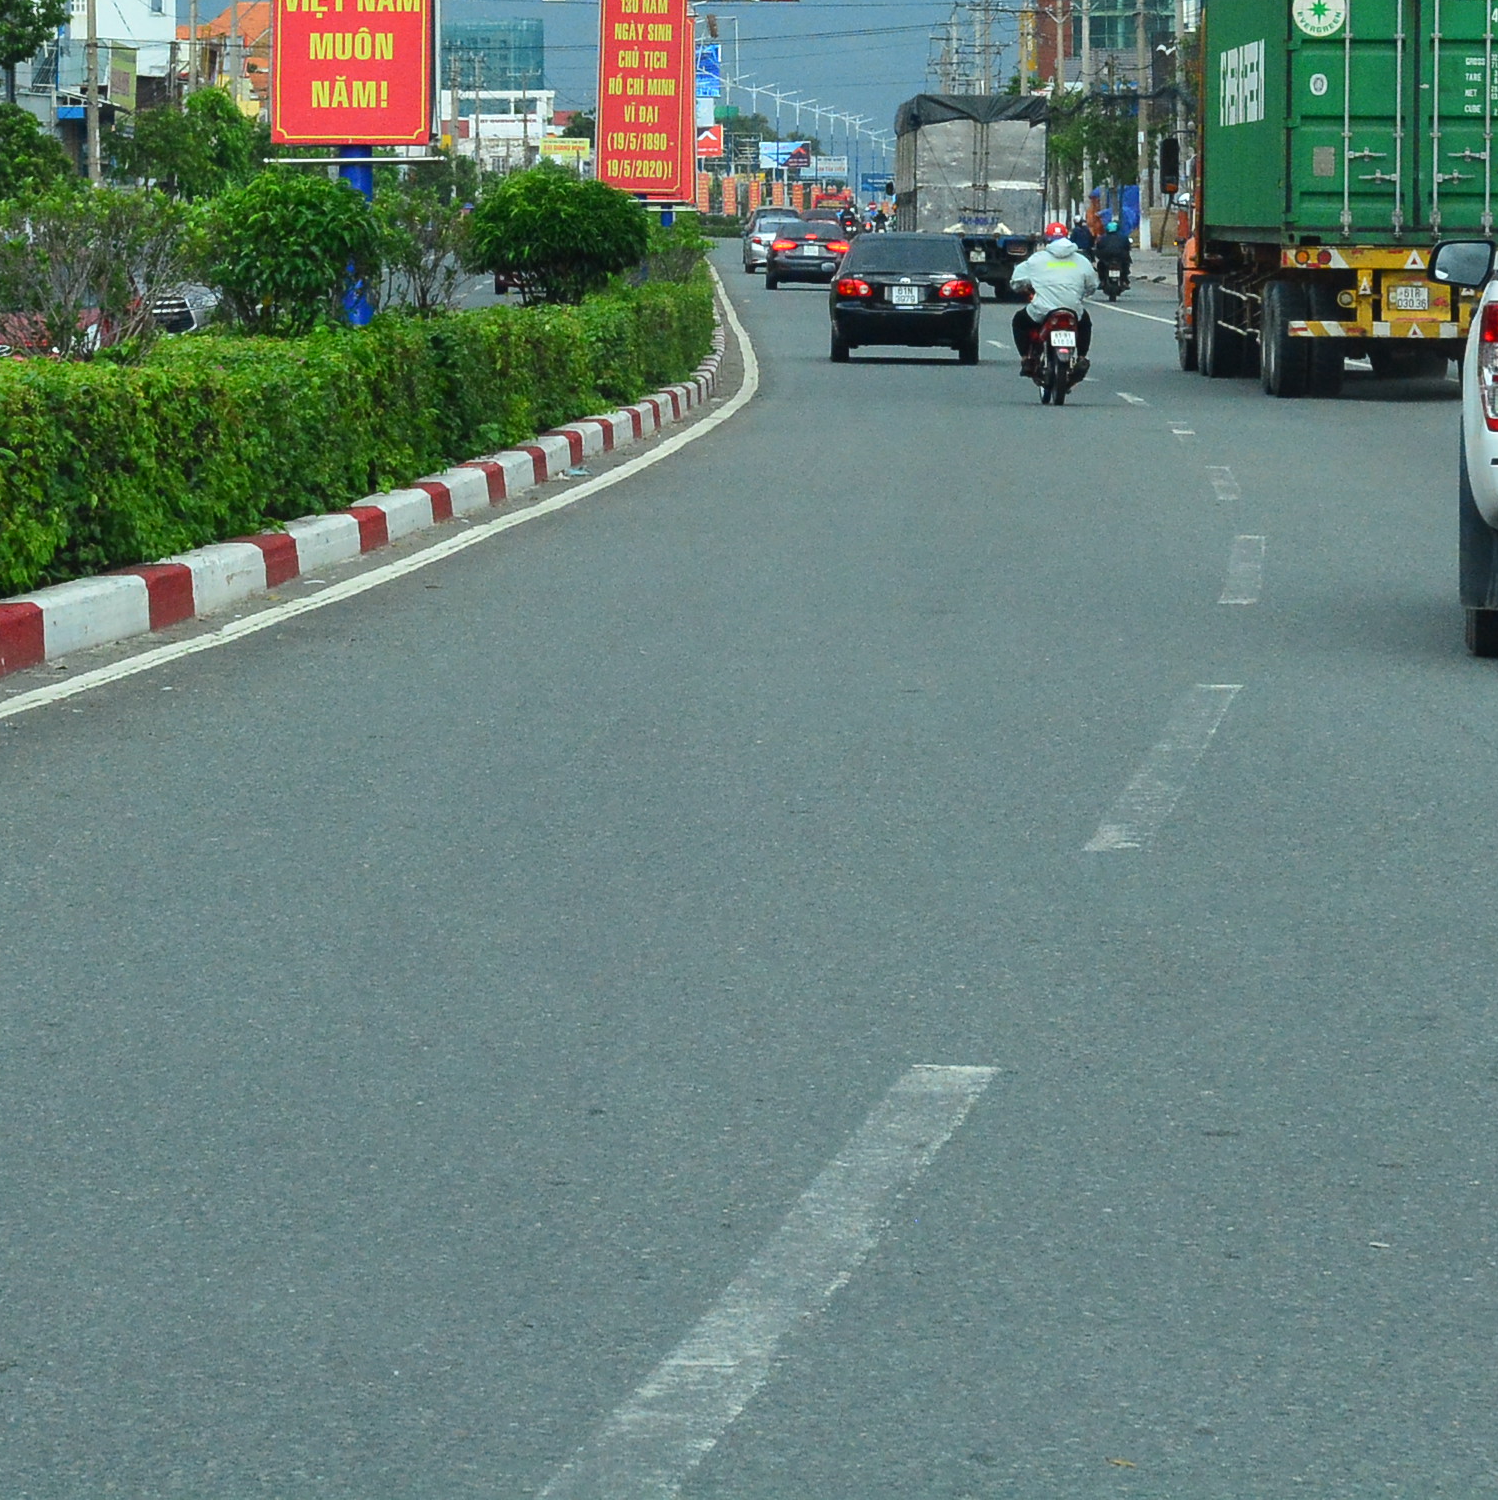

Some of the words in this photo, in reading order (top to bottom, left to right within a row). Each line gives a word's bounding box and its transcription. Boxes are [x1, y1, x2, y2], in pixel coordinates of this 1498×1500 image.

[615, 20, 644, 40] NGÀY
[648, 24, 672, 41] SINH
[1297, 11, 1342, 33] EVERGREEN
[310, 27, 393, 60] MUÔN
[618, 46, 639, 68] CHỦ
[644, 51, 667, 72] TỊCH
[608, 73, 623, 95] HỒ
[627, 74, 644, 95] CHÍ
[647, 79, 675, 96] MINH
[1465, 72, 1482, 81] TARE
[312, 76, 388, 108] NĂM!
[1465, 88, 1477, 97] NET
[624, 102, 636, 122] VĨ
[639, 106, 659, 127] ĐẠI
[607, 132, 667, 151] (19/5/1890
[607, 159, 673, 180] 19/5/2020)!
